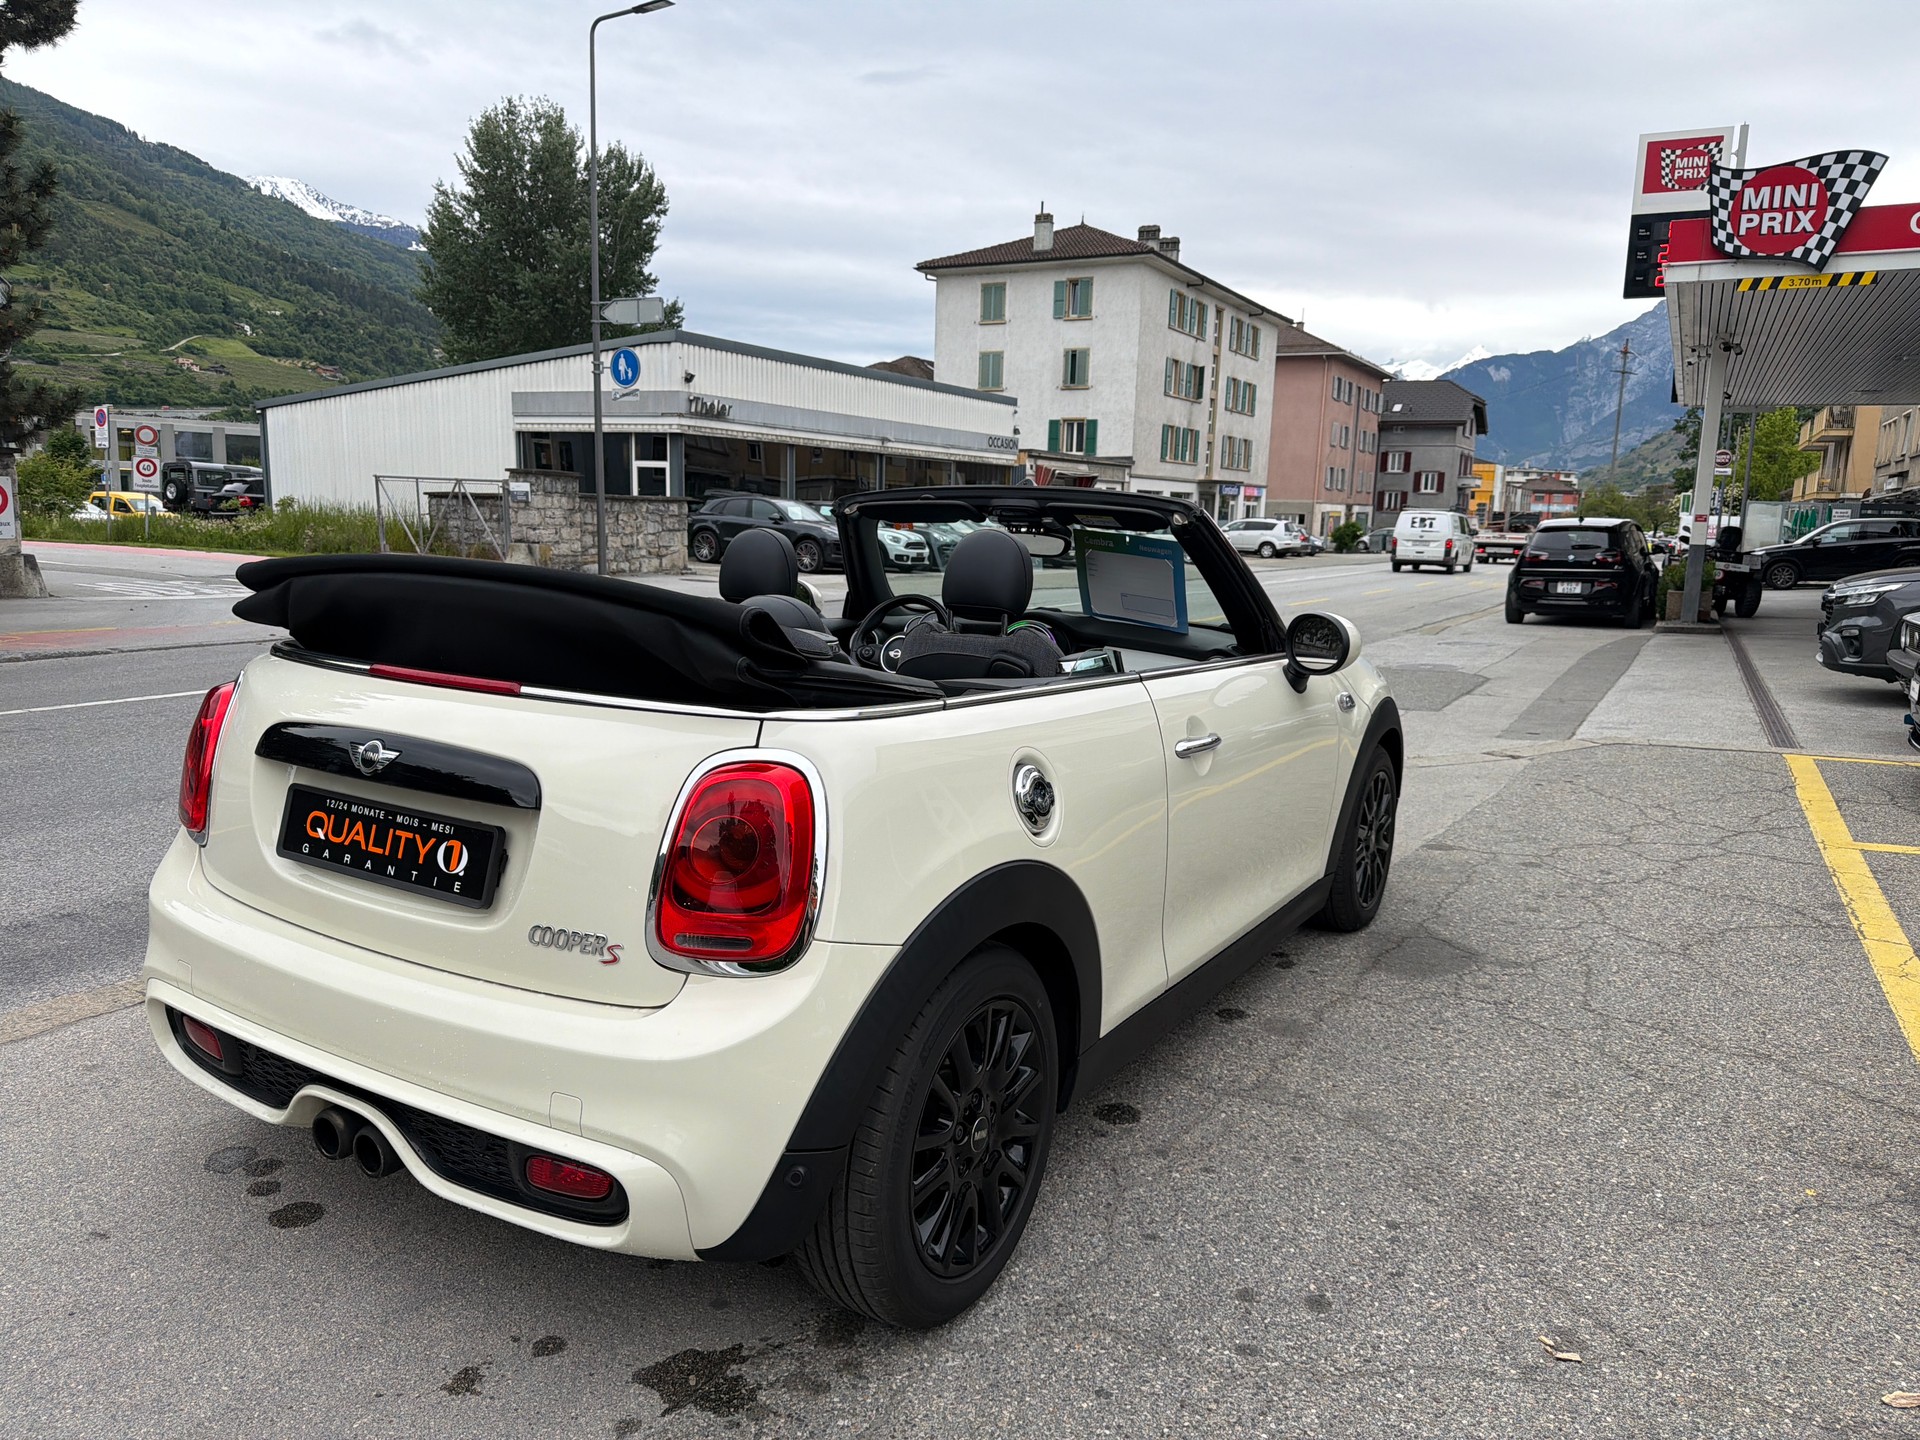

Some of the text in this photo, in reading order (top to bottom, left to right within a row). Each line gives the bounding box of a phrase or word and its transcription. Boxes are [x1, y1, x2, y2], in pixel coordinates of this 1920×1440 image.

[1675, 155, 1709, 169] MINI
[1673, 167, 1708, 180] PRIX
[1741, 182, 1819, 211] MINI
[1738, 209, 1817, 237] PRIX
[987, 436, 1019, 451] OCCASION
[141, 464, 152, 472] 40
[1410, 516, 1437, 529] EBT
[1083, 535, 1114, 548] Cembra
[1138, 544, 1173, 556] Neuwagen
[362, 750, 379, 762] MINI
[326, 799, 348, 811] 12/24
[350, 804, 385, 820] MONATE
[396, 814, 419, 827] MOIS
[431, 822, 455, 835] MESI
[306, 810, 437, 864] QUALITY
[302, 843, 462, 893] GARANTIE
[528, 924, 625, 965] COOPER S
